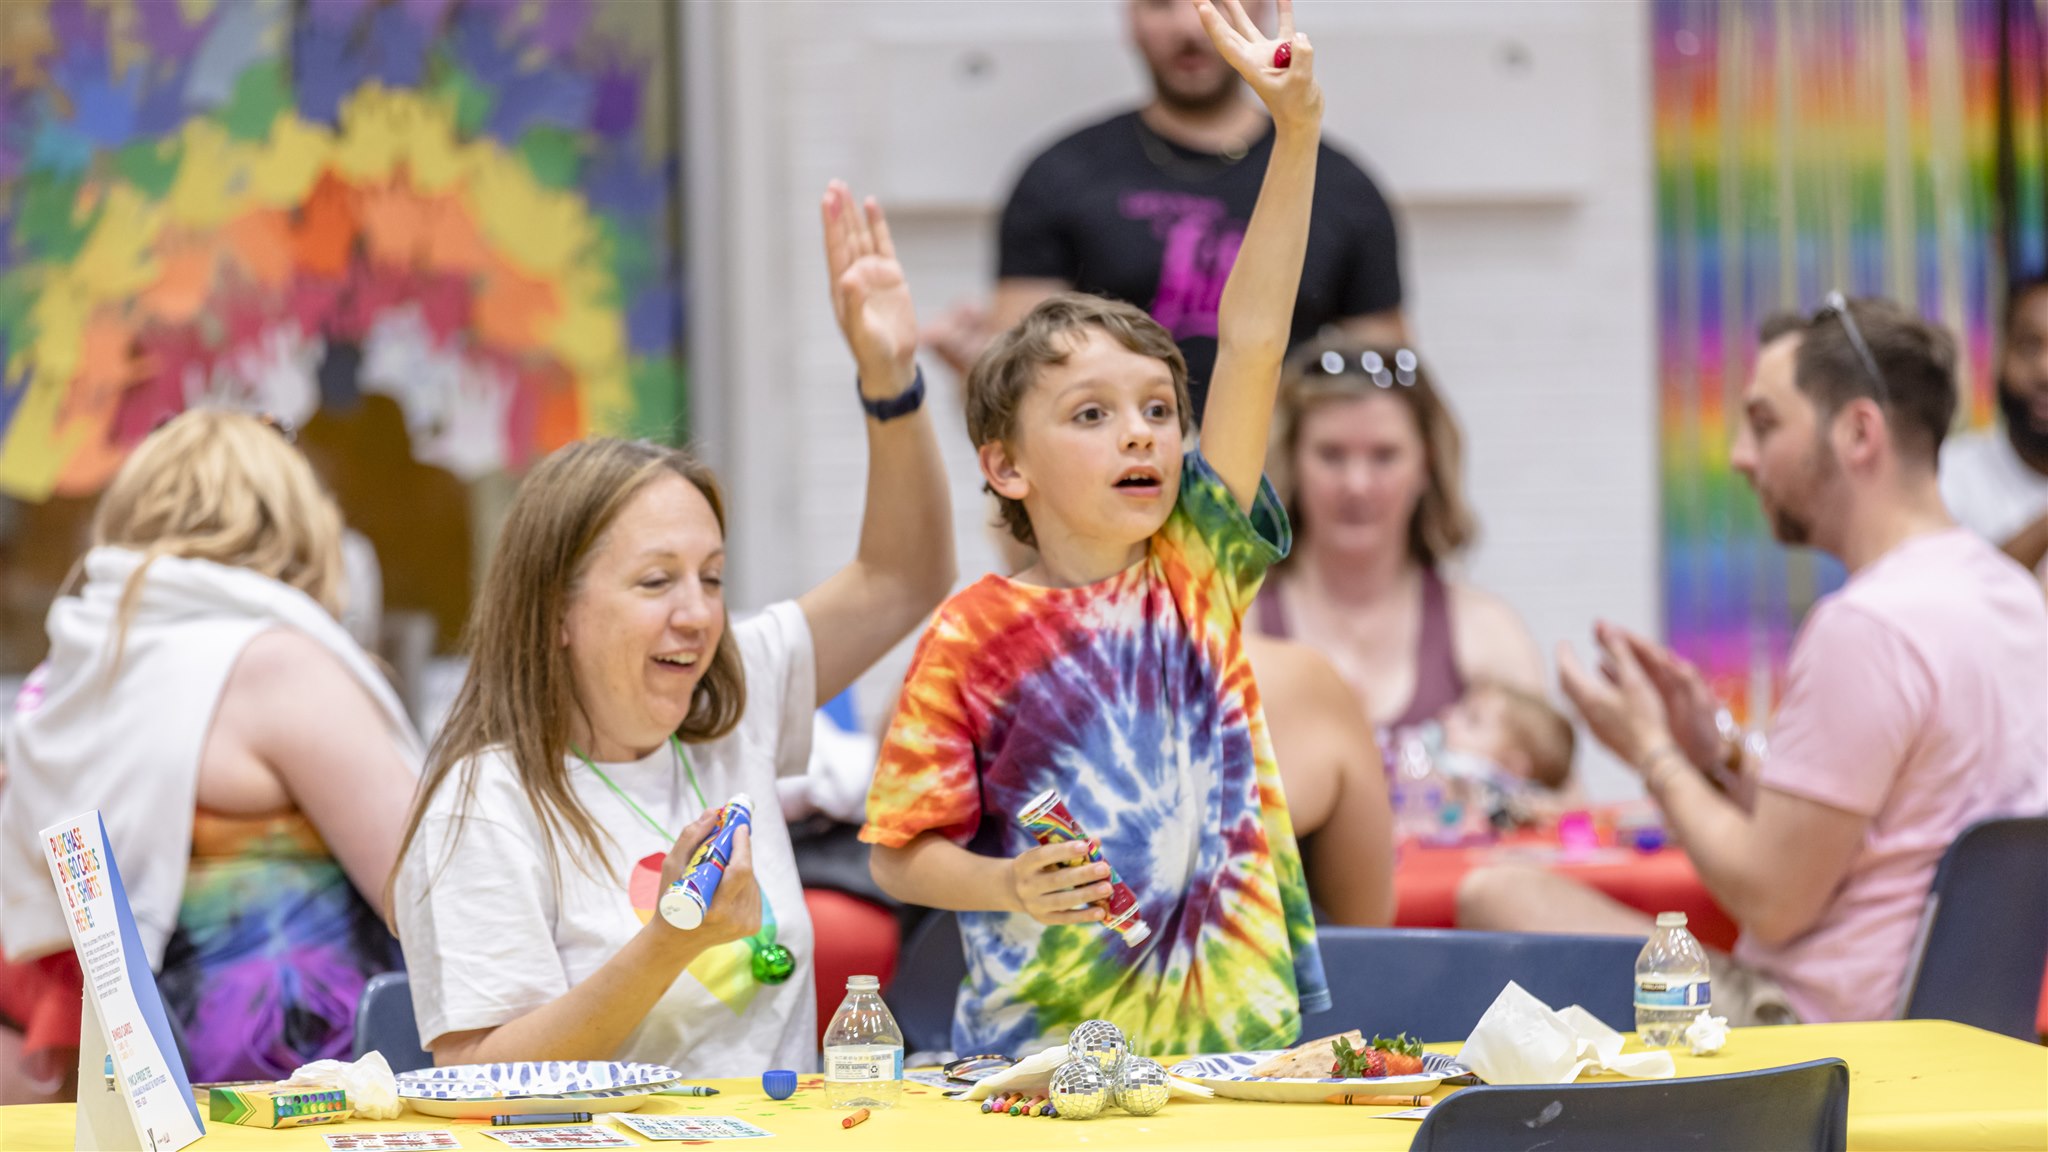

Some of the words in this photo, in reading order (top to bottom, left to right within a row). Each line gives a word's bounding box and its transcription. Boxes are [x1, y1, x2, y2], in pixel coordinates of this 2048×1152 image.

[49, 827, 85, 859] PURCHASE
[57, 856, 80, 884] BINGO
[77, 848, 100, 876] CARDS
[66, 886, 75, 909] &
[71, 875, 103, 905] T-SHIRTS
[73, 906, 95, 934] HERE!
